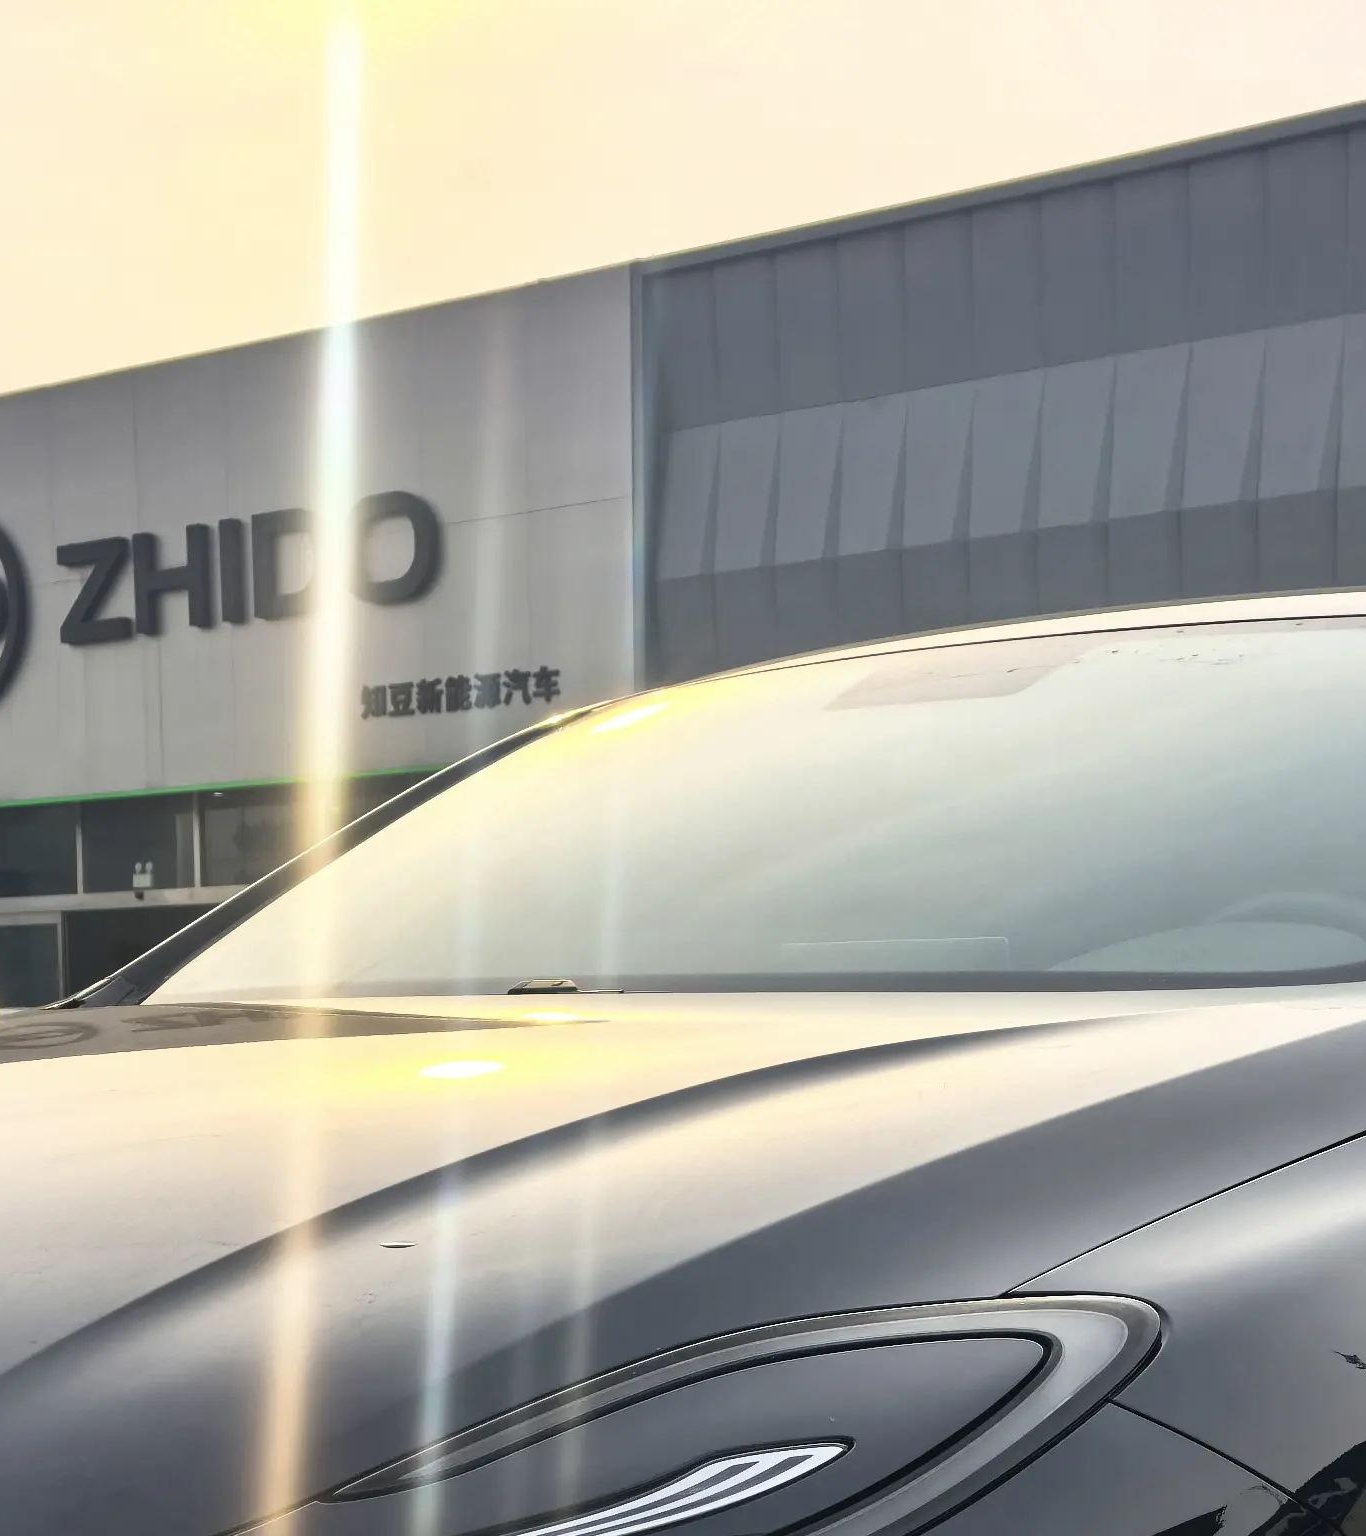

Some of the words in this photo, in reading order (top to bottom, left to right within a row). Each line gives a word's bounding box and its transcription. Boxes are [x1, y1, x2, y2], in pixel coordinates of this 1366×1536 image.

[56, 490, 442, 648] ZHIDO
[361, 665, 561, 719] 知豆新能源汽车
